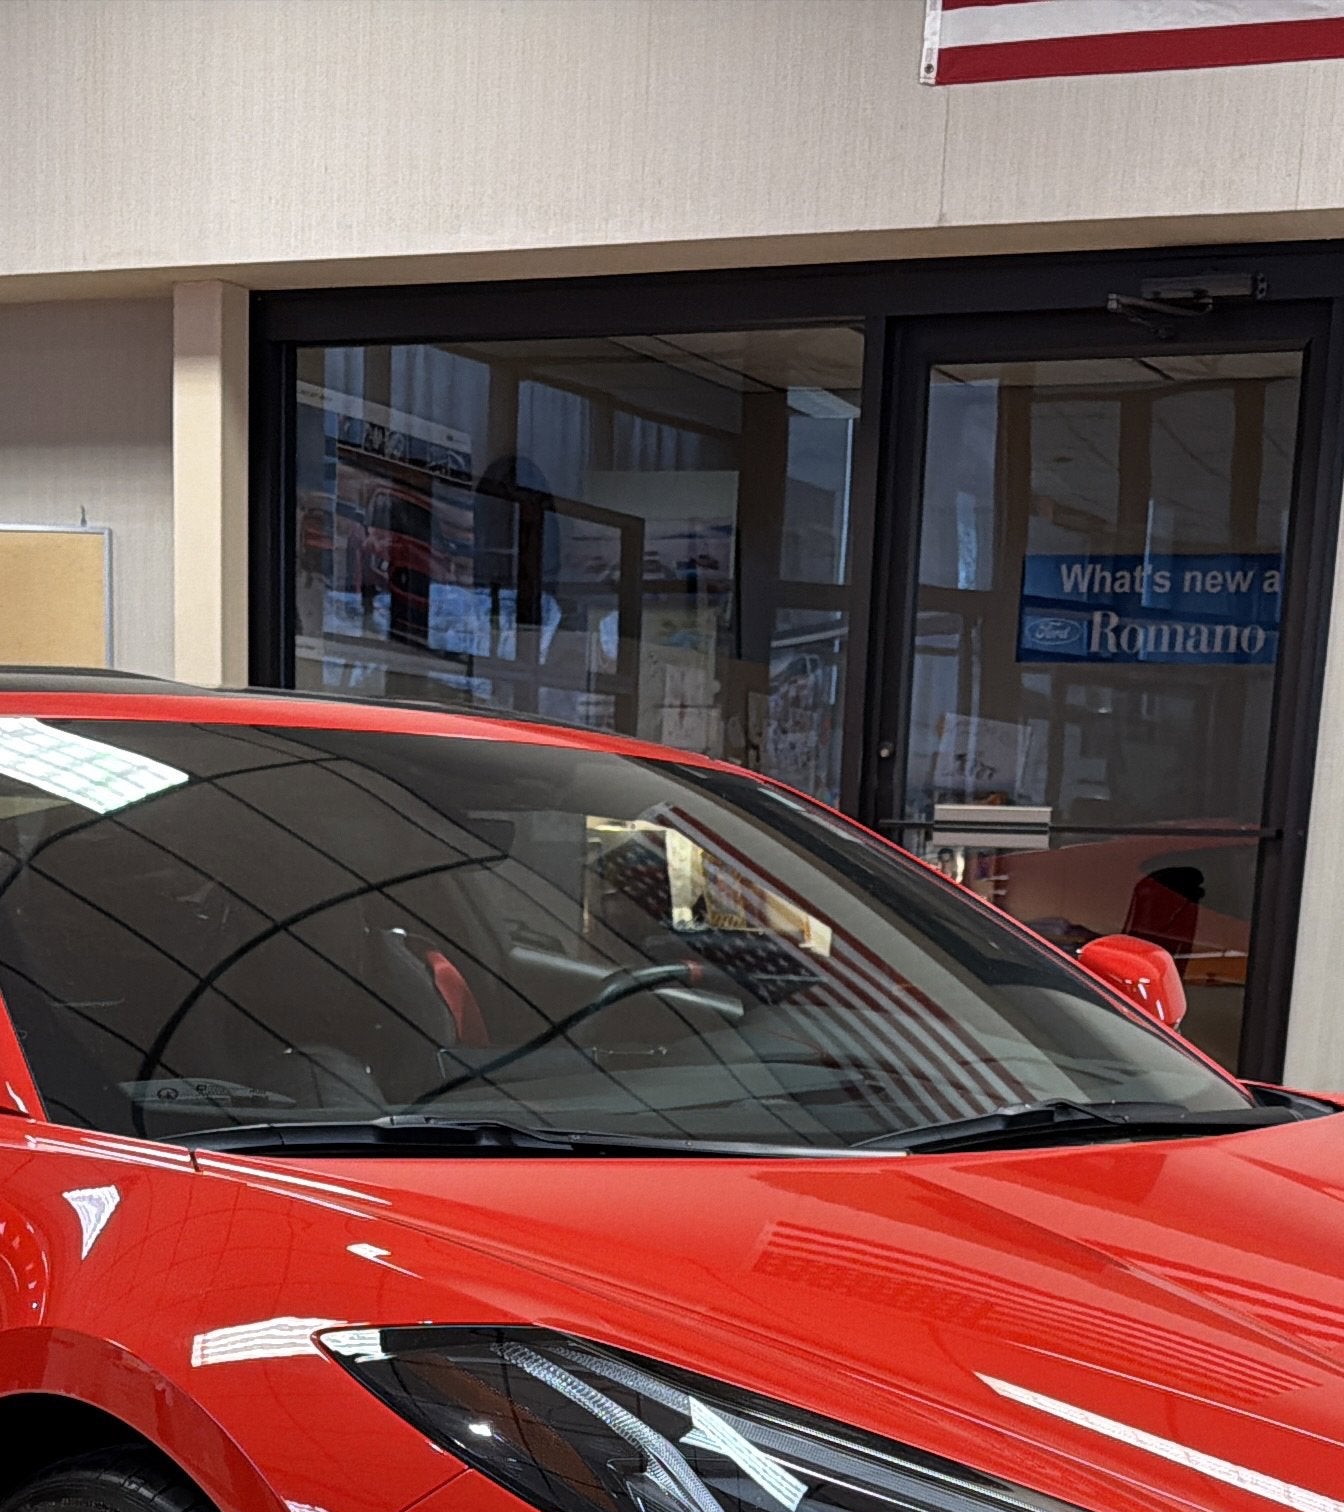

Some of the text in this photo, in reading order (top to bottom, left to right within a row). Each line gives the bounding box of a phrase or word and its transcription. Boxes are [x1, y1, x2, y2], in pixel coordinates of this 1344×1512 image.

[1060, 563, 1171, 594] What's
[1183, 569, 1255, 594] new
[1090, 610, 1266, 654] Romano
